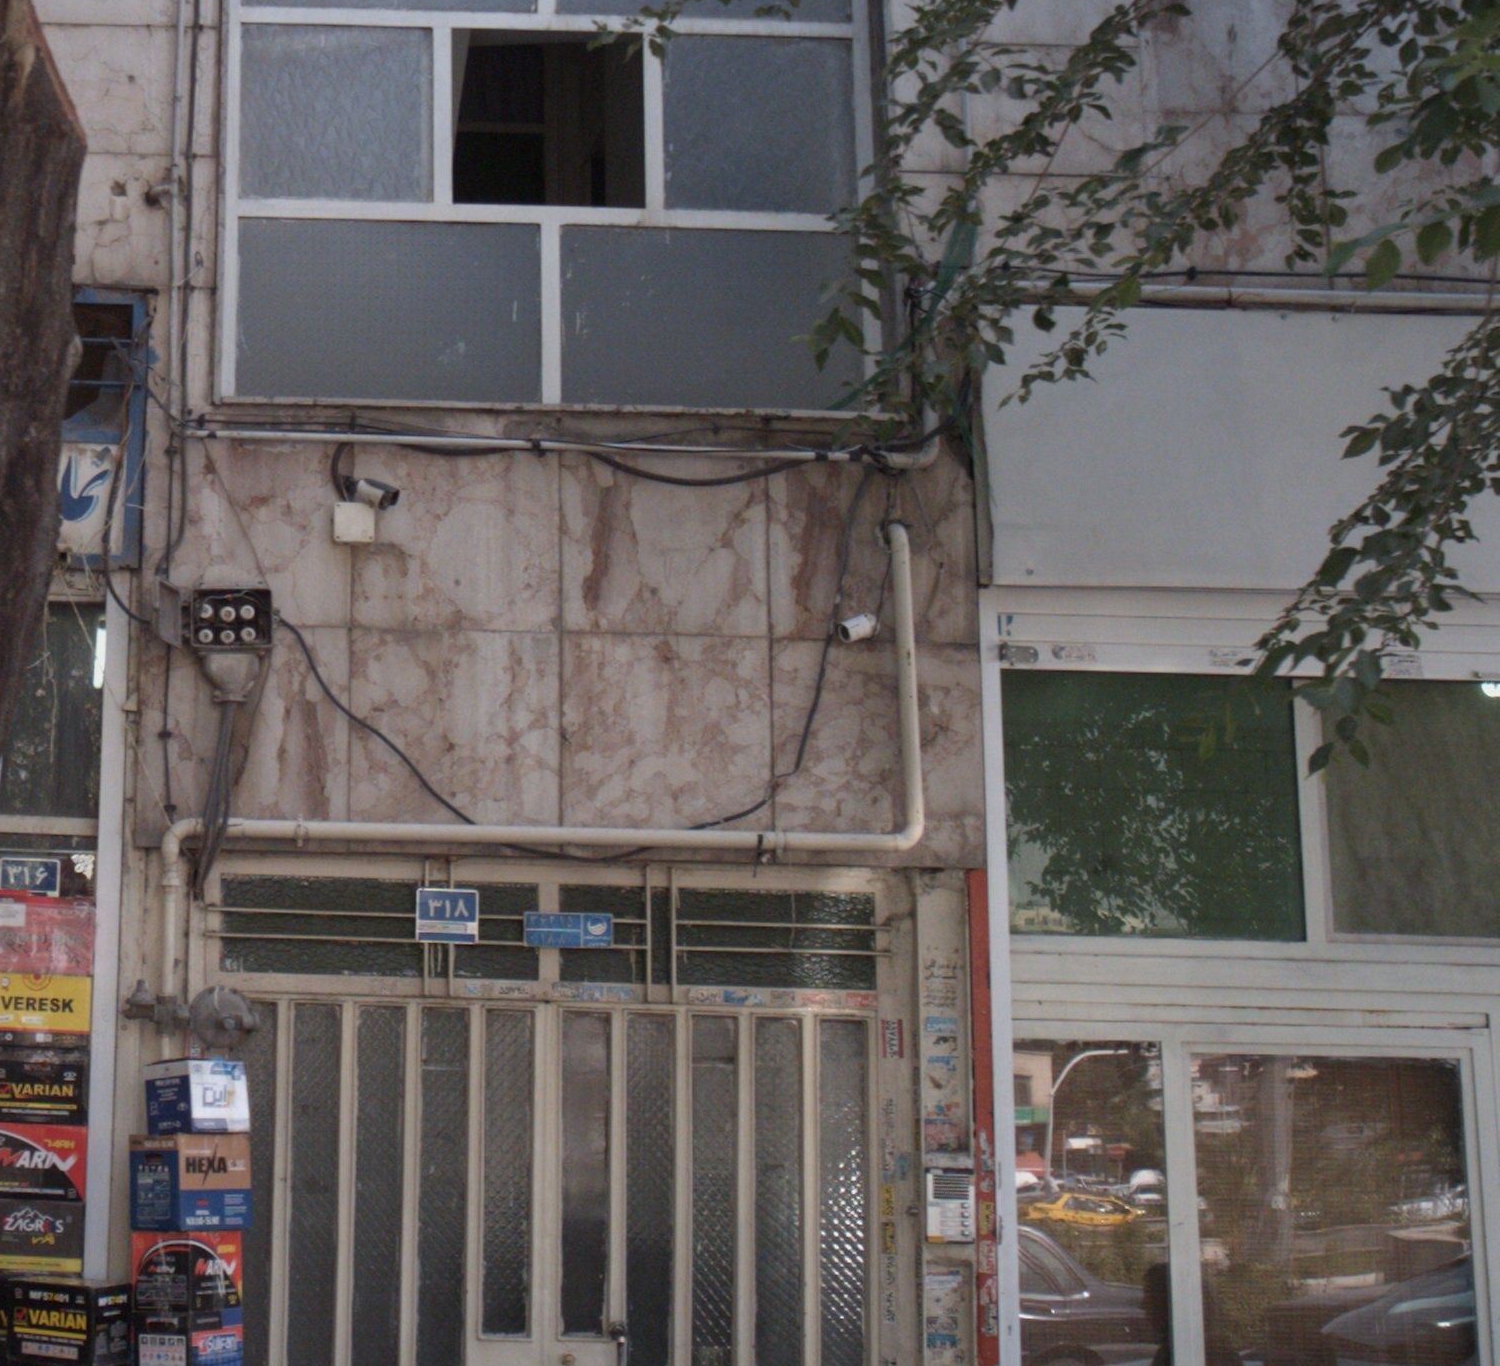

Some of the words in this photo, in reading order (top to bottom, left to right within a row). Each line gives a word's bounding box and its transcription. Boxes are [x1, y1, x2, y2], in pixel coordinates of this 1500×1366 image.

[6, 864, 48, 885] ۳۱۶
[428, 898, 469, 918] ۳۱۸
[1, 995, 74, 1013] VERESK
[11, 1083, 74, 1098] VARIAN
[185, 1149, 228, 1179] HEXA
[29, 1309, 87, 1330] VARIAN
